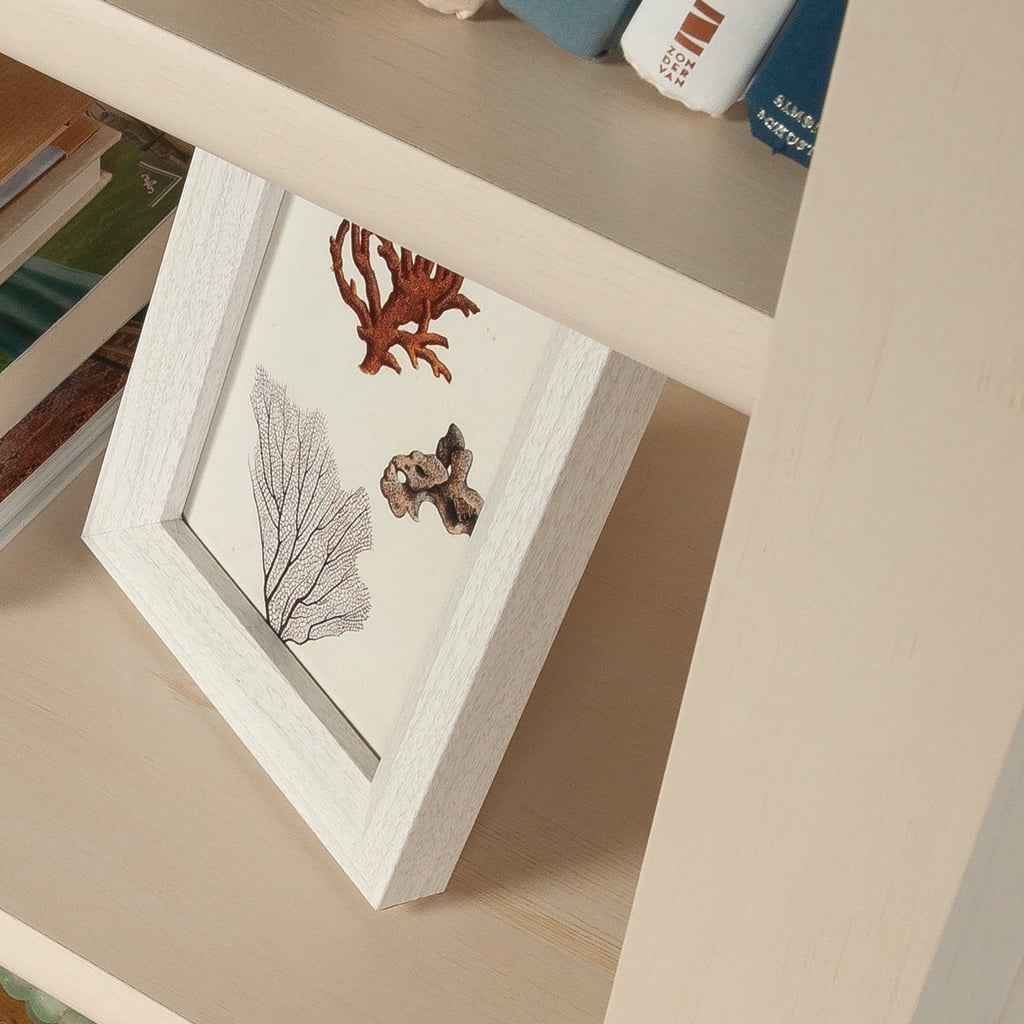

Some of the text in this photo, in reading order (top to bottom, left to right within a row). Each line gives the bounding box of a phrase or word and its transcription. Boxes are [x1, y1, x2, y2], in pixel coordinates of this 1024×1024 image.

[662, 55, 689, 79] DER
[666, 45, 696, 70] ZON
[659, 64, 685, 88] VAN
